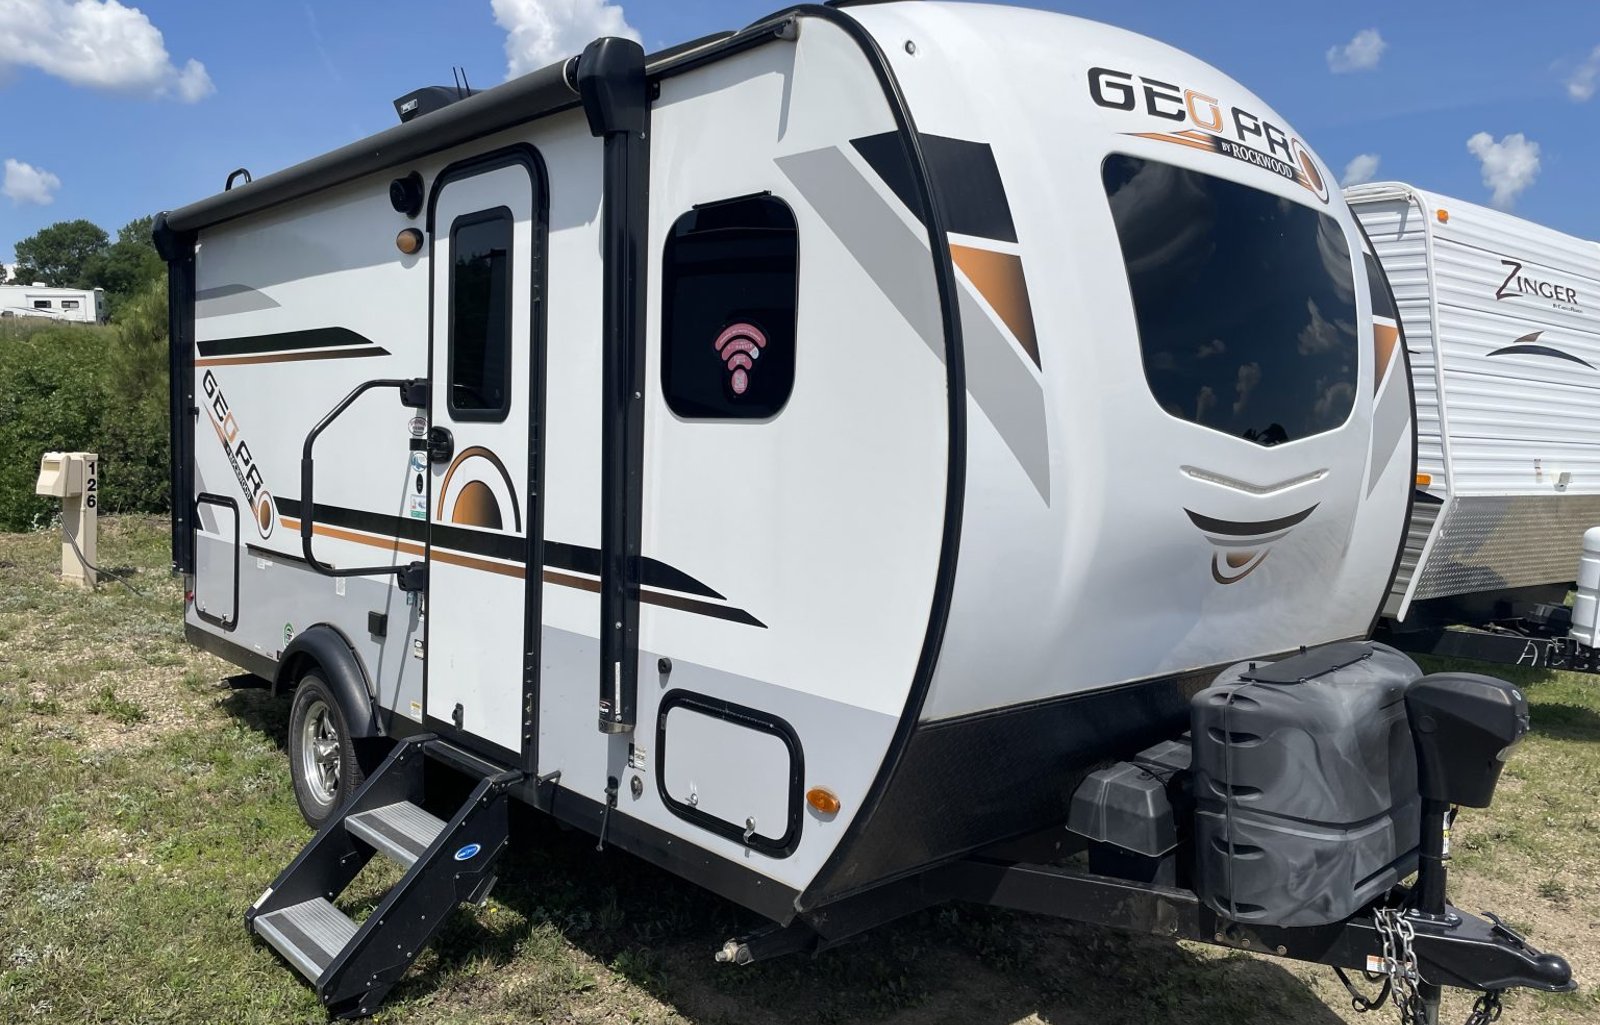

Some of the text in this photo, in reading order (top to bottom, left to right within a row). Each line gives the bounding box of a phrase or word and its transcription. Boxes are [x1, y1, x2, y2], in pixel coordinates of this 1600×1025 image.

[1087, 66, 1223, 133] GEO
[1221, 142, 1293, 179] BY ROCKWOOD
[202, 369, 239, 443] GEO
[86, 461, 97, 508] 126
